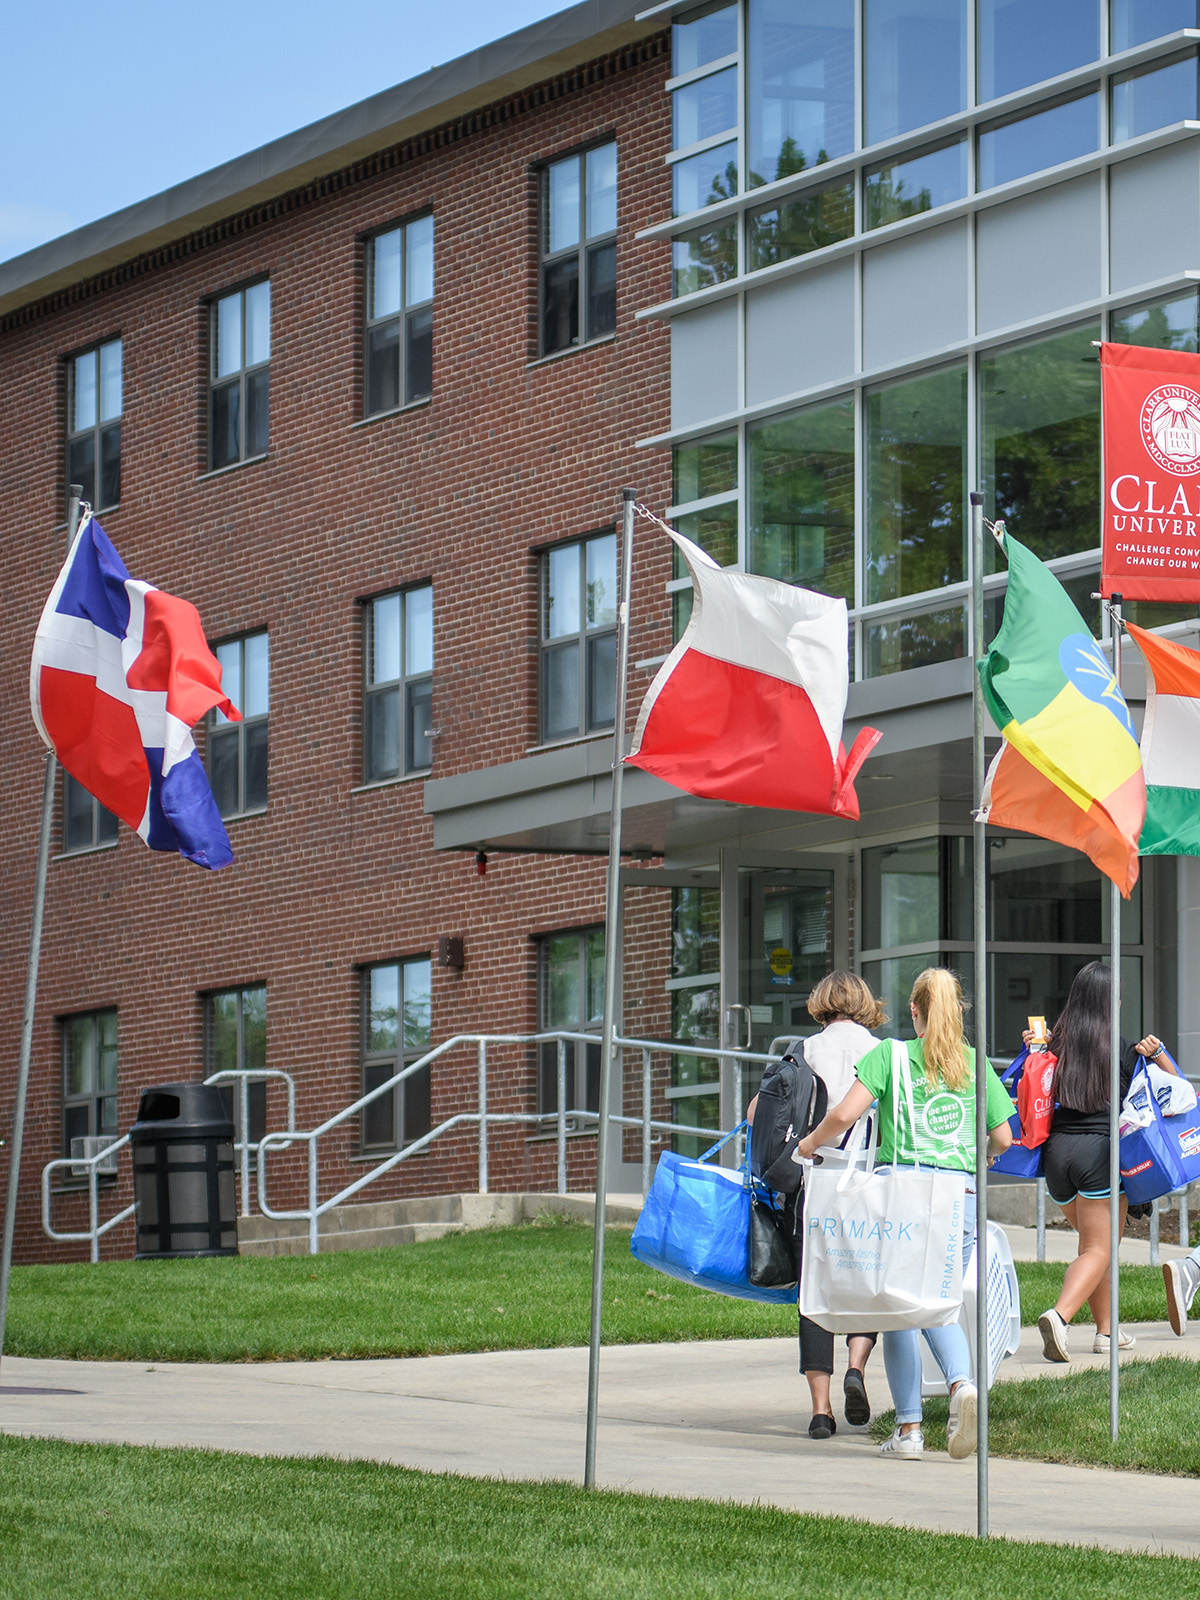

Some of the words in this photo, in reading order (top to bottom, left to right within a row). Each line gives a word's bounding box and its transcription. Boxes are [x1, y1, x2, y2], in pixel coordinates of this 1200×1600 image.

[1143, 391, 1164, 433] CLARK
[1170, 431, 1191, 440] FIAT
[1171, 440, 1191, 449] LUX
[1115, 543, 1171, 555] CHALLENGE
[1126, 556, 1164, 567] CHANGE
[1168, 559, 1187, 569] OUR
[928, 1106, 940, 1117] the
[941, 1102, 959, 1113] next
[929, 1111, 959, 1126] chapter
[933, 1120, 959, 1132] awaits
[808, 1217, 913, 1241] PRIMARK
[855, 1247, 881, 1261] fashio
[940, 1200, 960, 1299] PRIMARK.com
